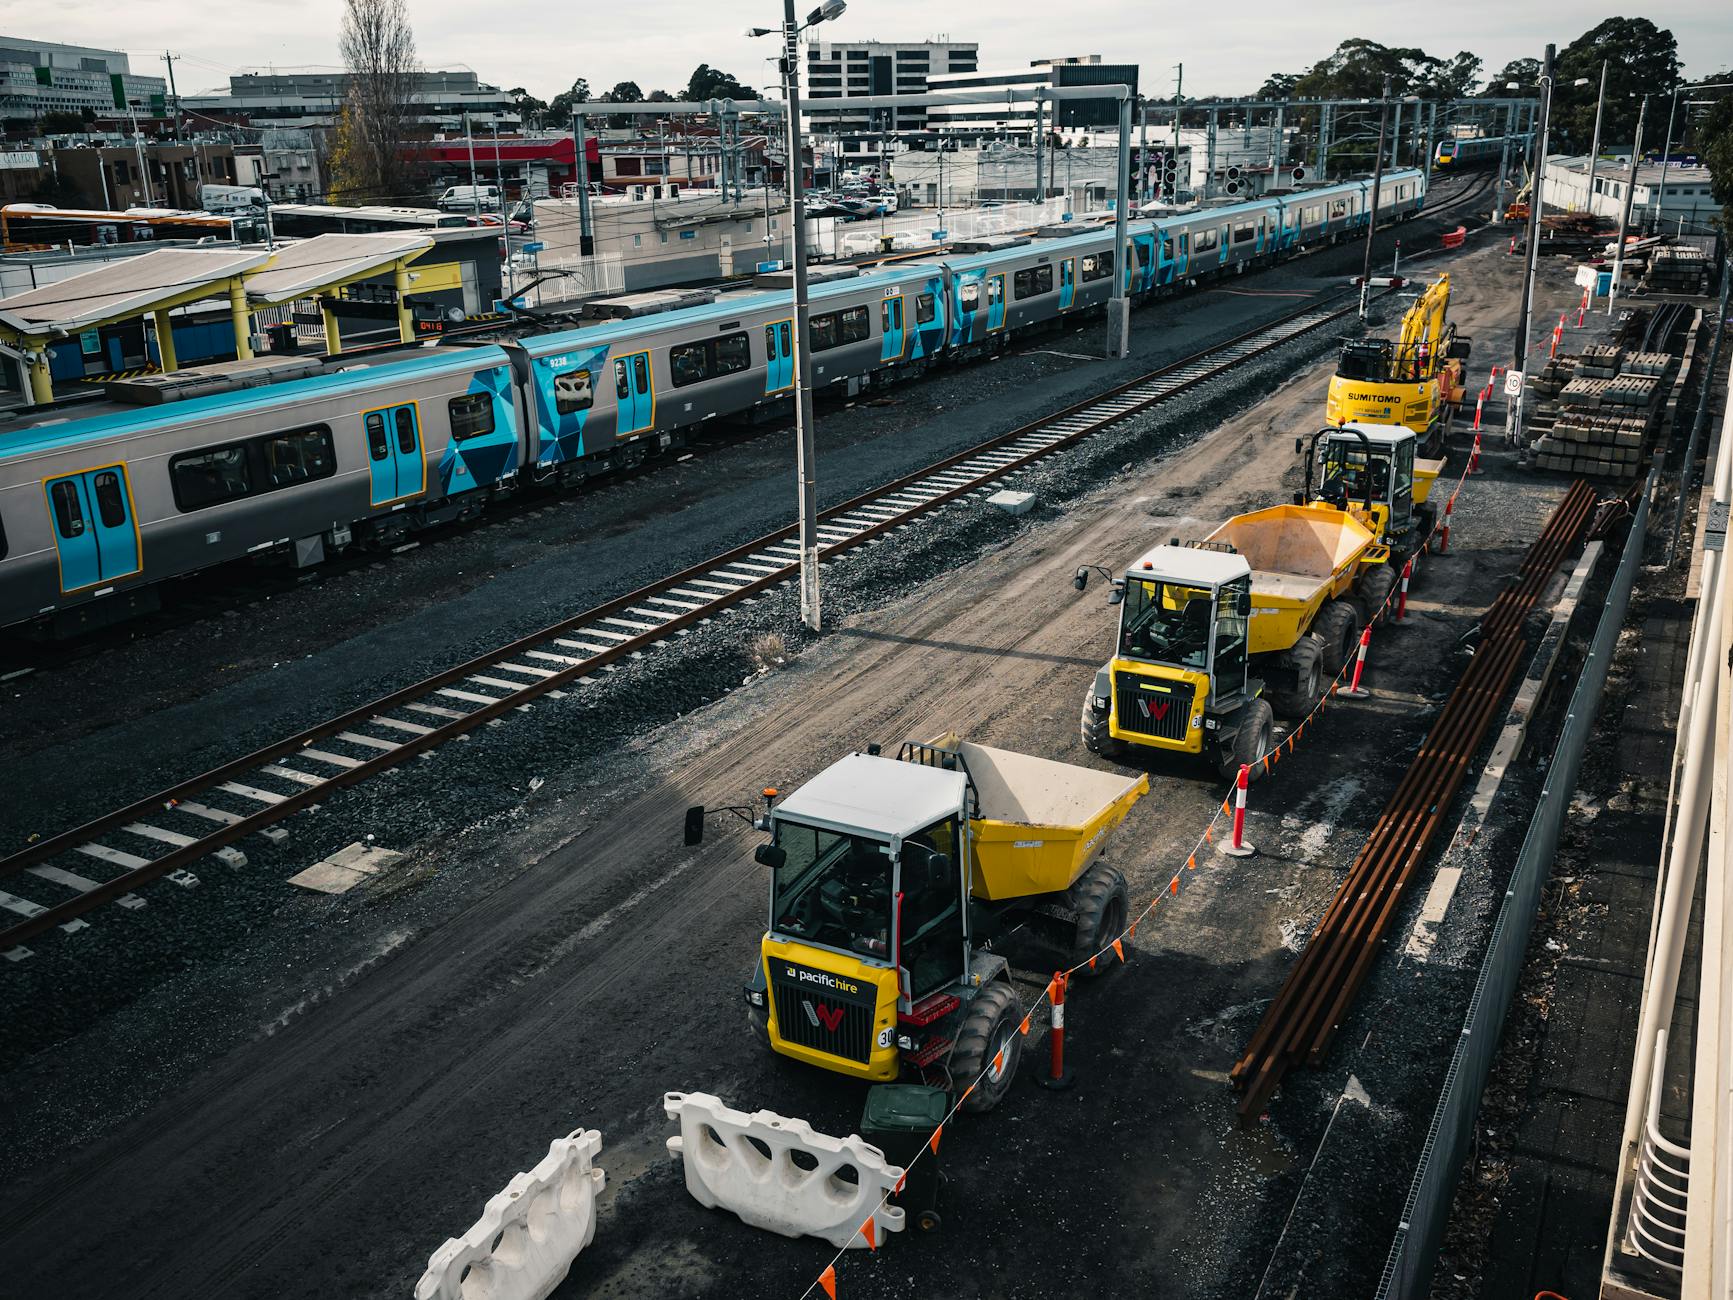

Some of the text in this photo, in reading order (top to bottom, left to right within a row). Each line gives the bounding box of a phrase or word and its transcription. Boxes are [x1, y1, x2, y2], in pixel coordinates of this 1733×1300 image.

[550, 357, 567, 368] 9238
[1510, 378, 1518, 387] 10
[1347, 392, 1401, 404] SUMITOMO
[800, 970, 858, 994] pacifichire
[880, 1029, 893, 1045] 30
